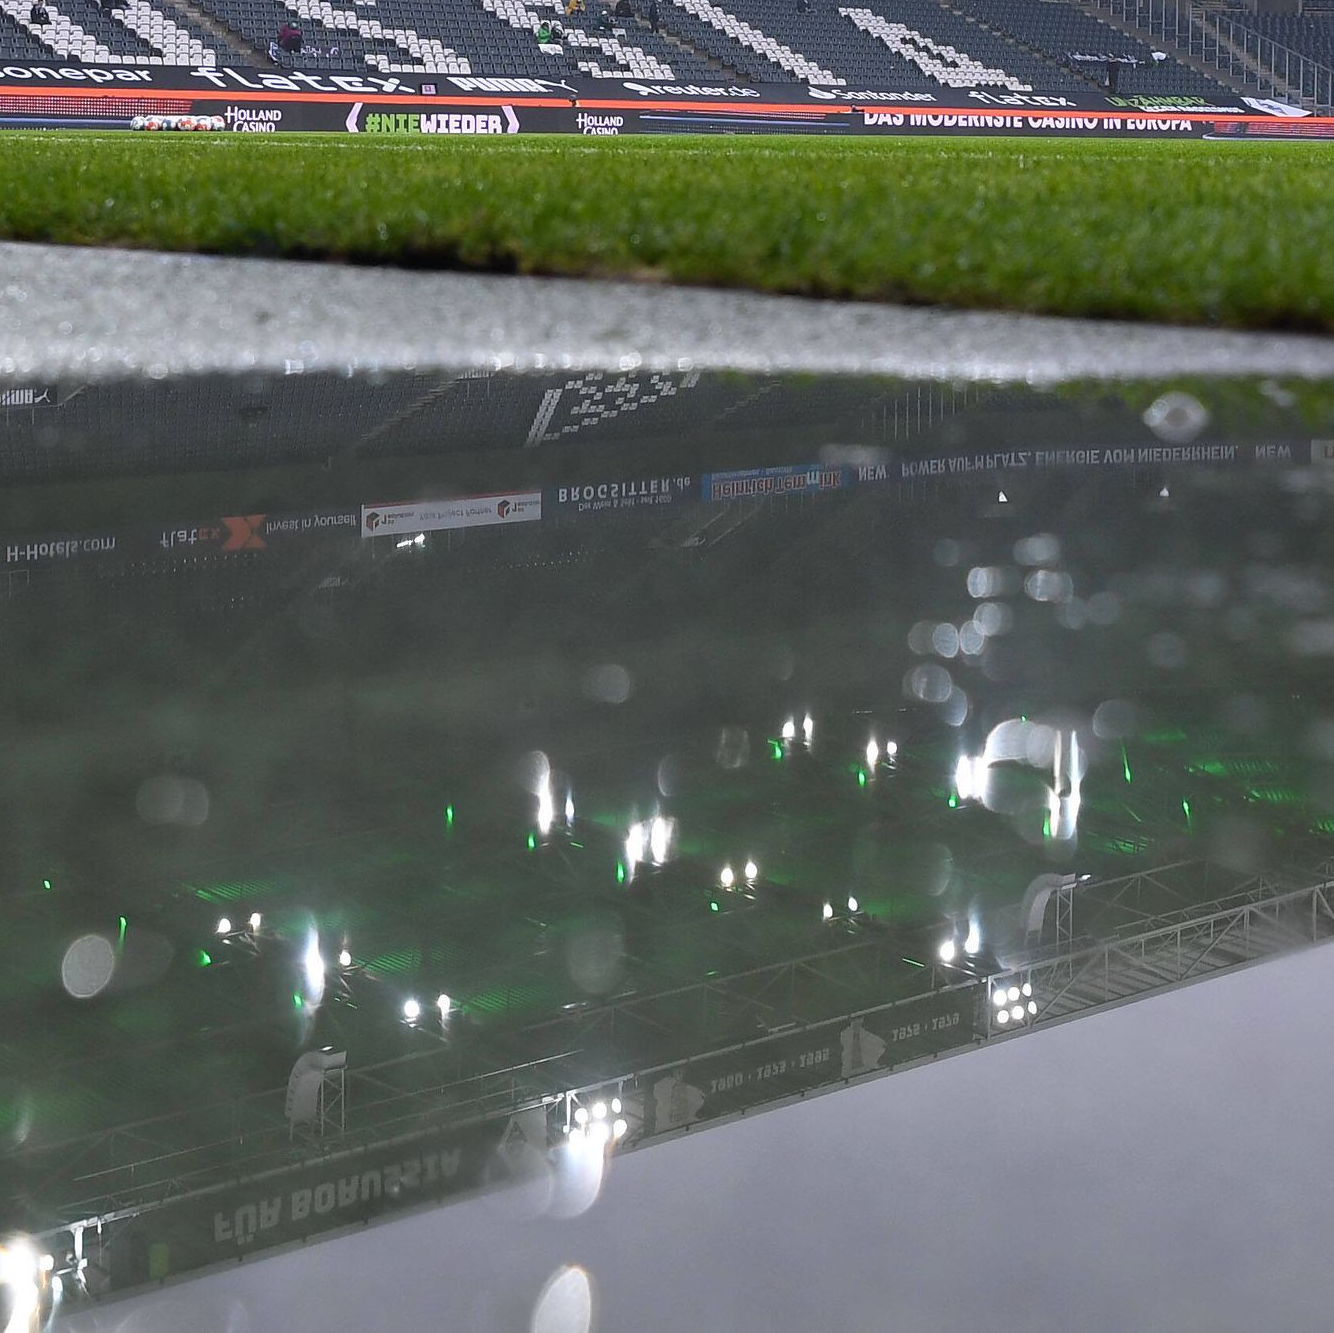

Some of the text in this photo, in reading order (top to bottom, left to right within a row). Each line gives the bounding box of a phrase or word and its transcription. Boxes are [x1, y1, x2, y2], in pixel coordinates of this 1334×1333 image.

[832, 89, 937, 102] Santander
[225, 106, 282, 122] HOLLAND
[576, 112, 623, 128] HOLLAND
[864, 114, 904, 126] DAS
[233, 120, 275, 133] CASINO
[366, 113, 502, 134] #NIEWIEDER
